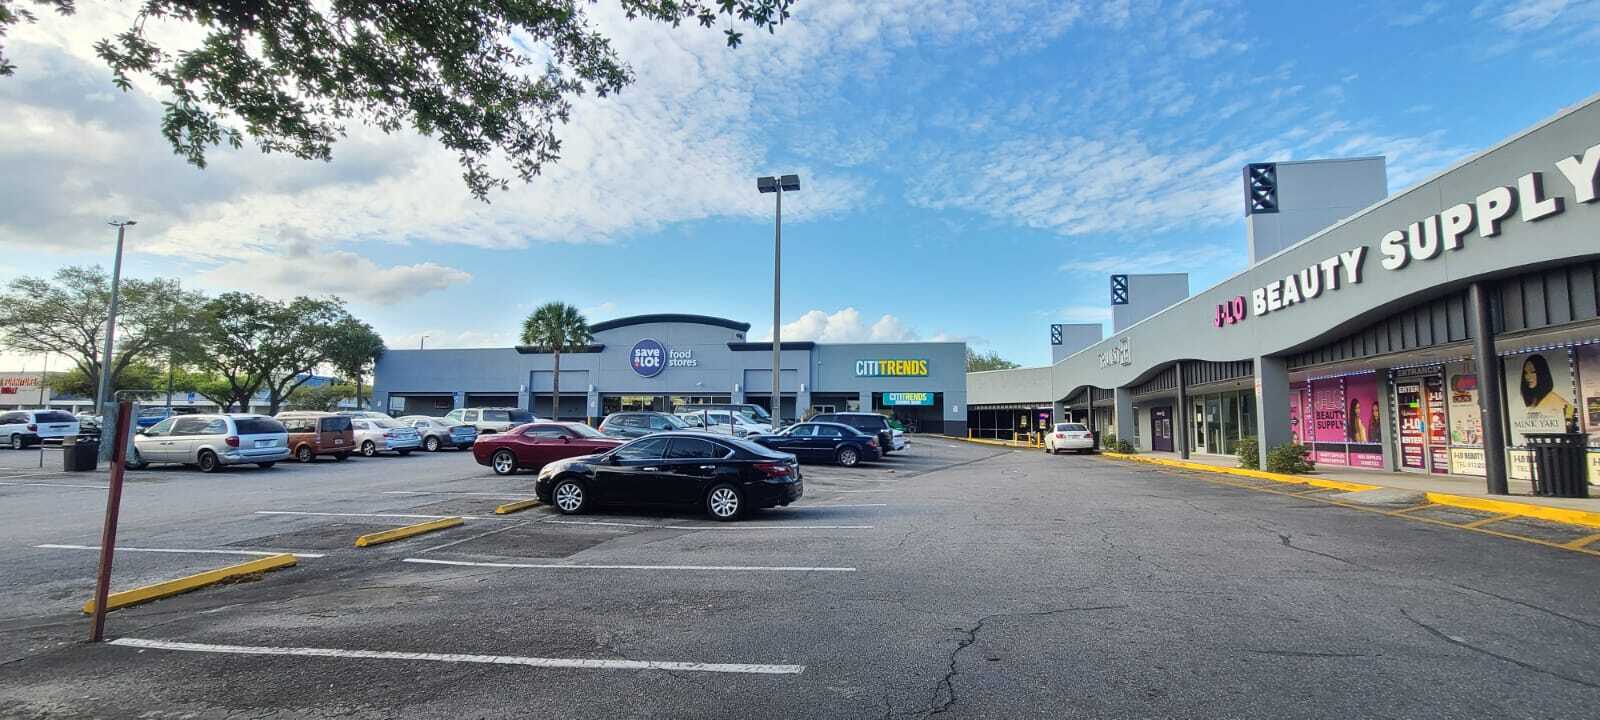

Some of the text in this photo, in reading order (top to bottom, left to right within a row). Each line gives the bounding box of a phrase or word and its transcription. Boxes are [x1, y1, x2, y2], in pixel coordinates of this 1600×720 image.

[1252, 246, 1368, 316] BEAUTY
[1380, 144, 1600, 271] SUPPLY
[634, 348, 660, 357] save
[670, 349, 692, 359] food
[669, 359, 697, 367] stores
[1398, 385, 1420, 394] ENTER
[1316, 410, 1345, 420] BEAUTY
[1317, 420, 1344, 430] SUPPLY
[1402, 436, 1424, 444] ENTER
